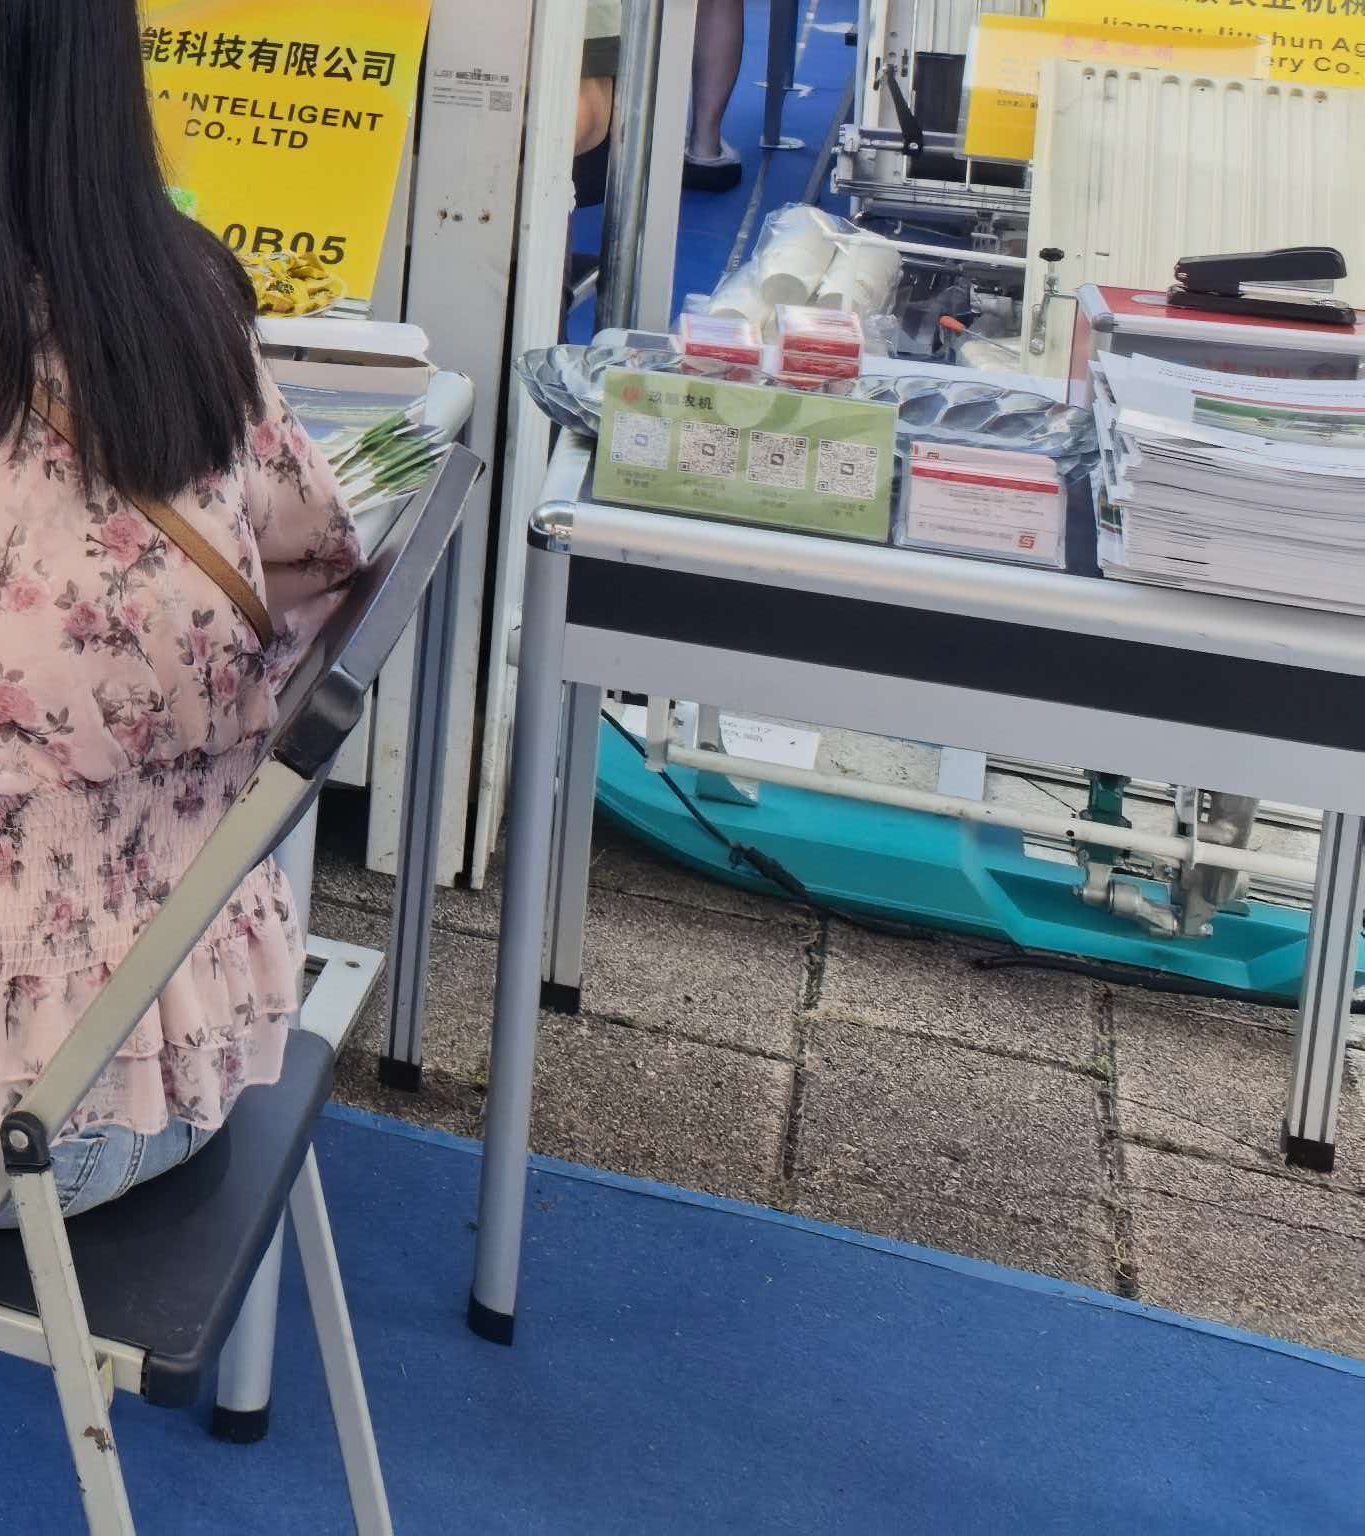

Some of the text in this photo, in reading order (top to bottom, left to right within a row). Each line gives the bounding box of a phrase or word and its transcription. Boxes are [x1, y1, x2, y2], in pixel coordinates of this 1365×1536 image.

[141, 27, 397, 86] 能科技有限公司
[252, 126, 309, 149] LTD
